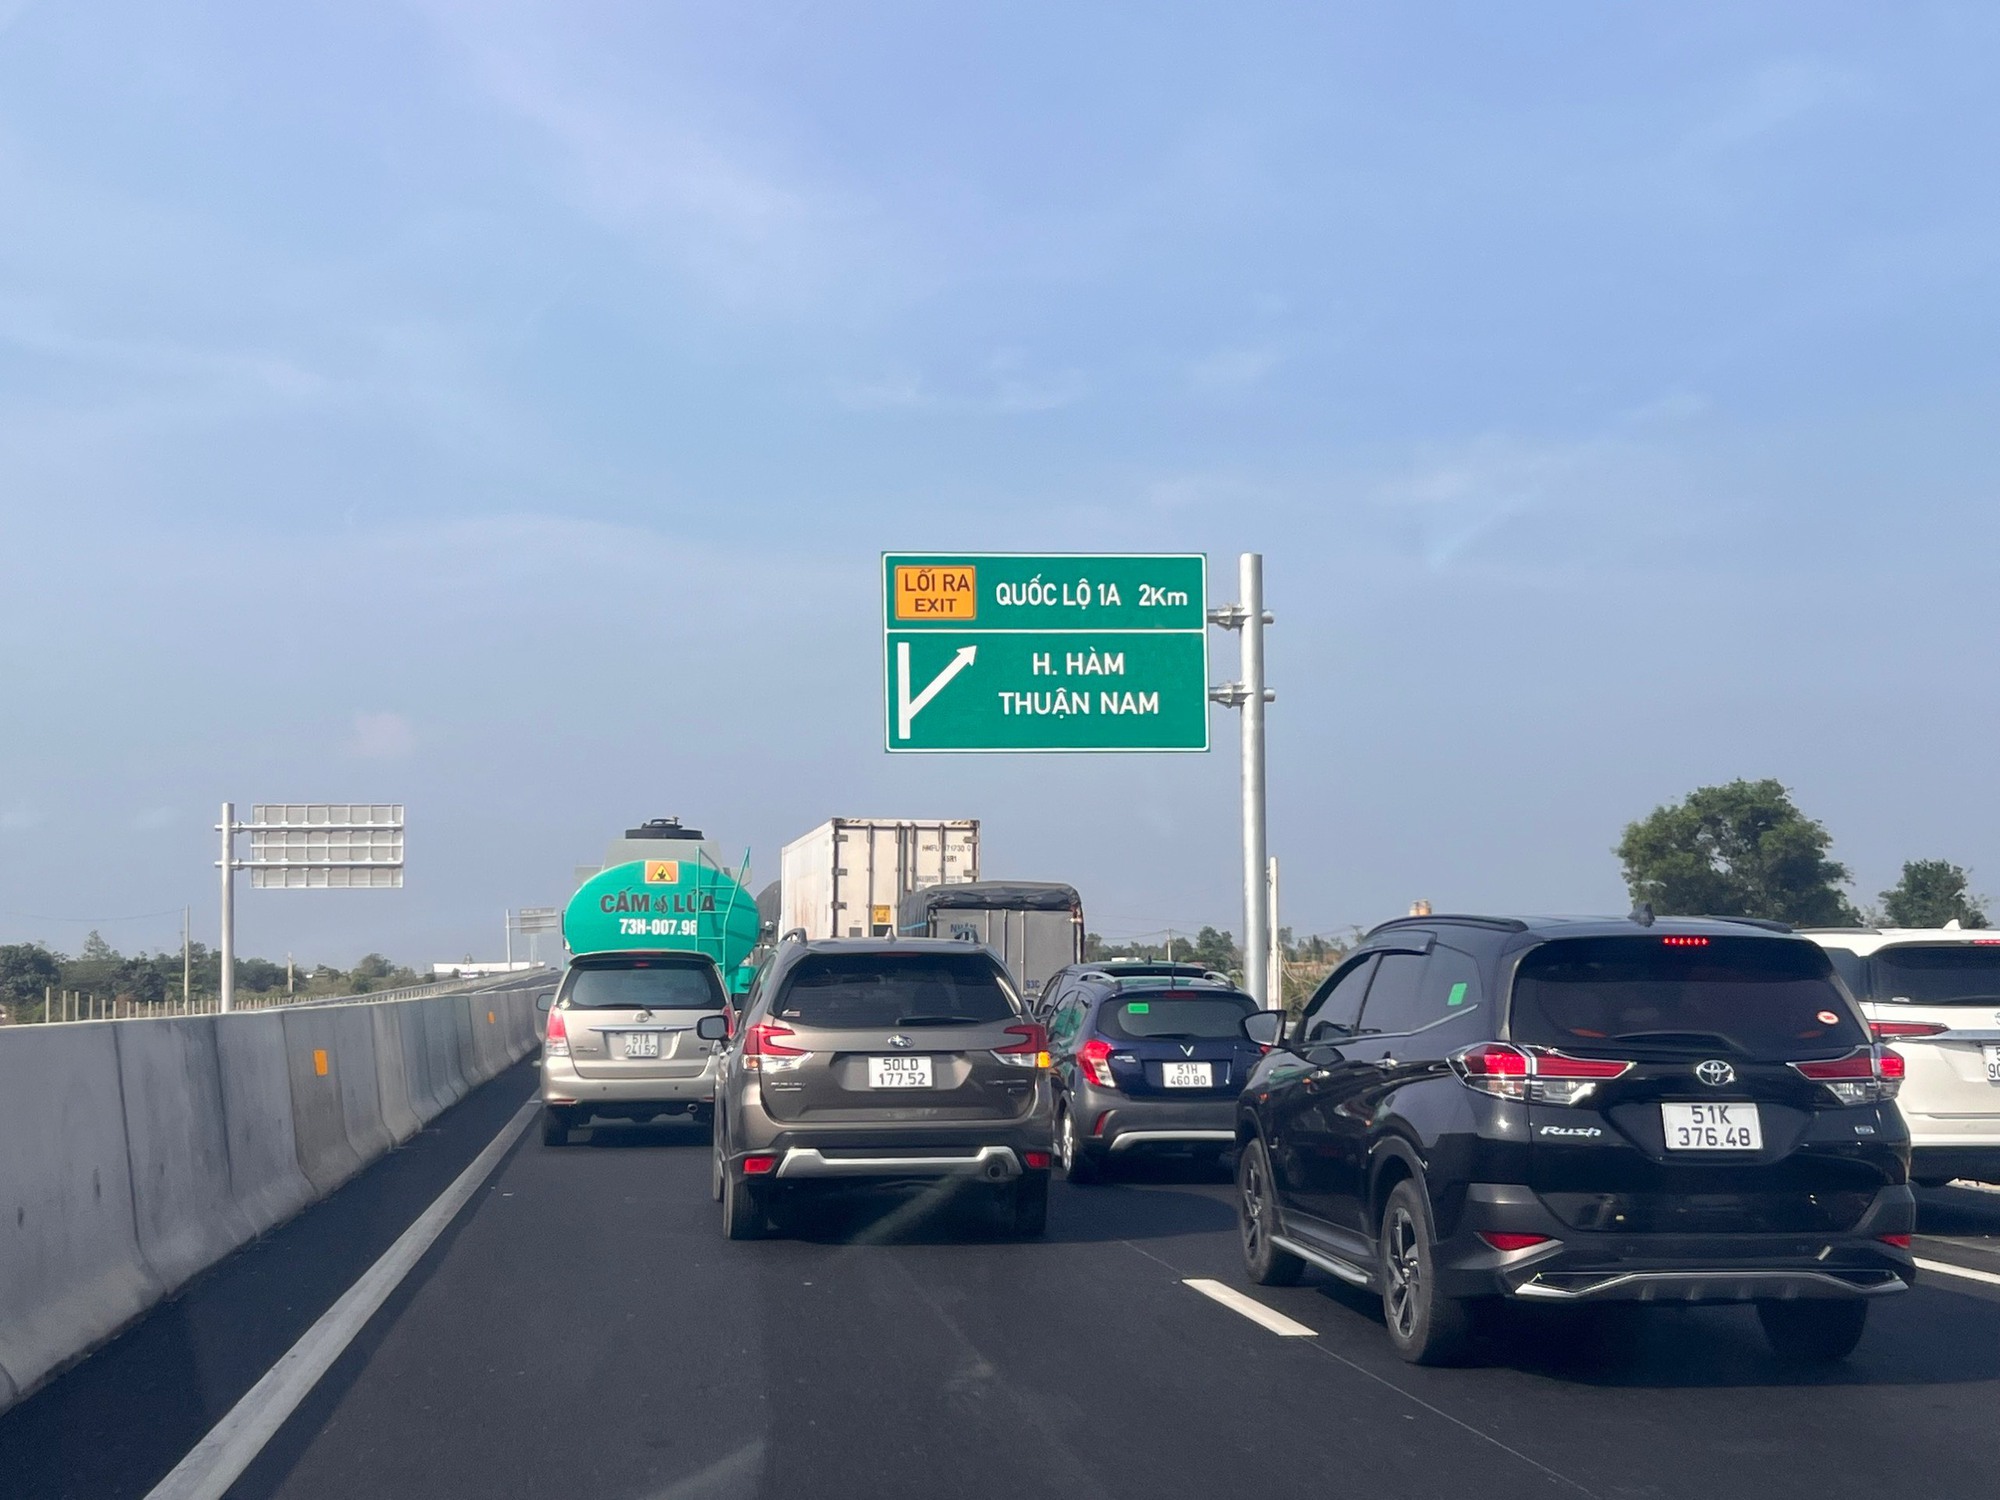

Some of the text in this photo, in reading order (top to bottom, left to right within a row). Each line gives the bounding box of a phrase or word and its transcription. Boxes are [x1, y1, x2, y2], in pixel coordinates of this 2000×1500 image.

[904, 569, 970, 592] LỐI RA
[995, 573, 1188, 610] QUỐC LỘ 1A 2Km
[914, 598, 957, 613] EXIT
[1032, 646, 1125, 676] H. HÀM
[998, 687, 1160, 719] THUẬN NAM
[600, 886, 716, 914] CẤM LỬA
[632, 1033, 650, 1044] 51A
[882, 1057, 919, 1071] 50LD
[1177, 1064, 1199, 1075] 51H
[878, 1072, 926, 1086] 177.52
[1690, 1105, 1730, 1125] 51K
[1540, 1125, 1602, 1139] Rush
[1678, 1127, 1751, 1148] 376.48
